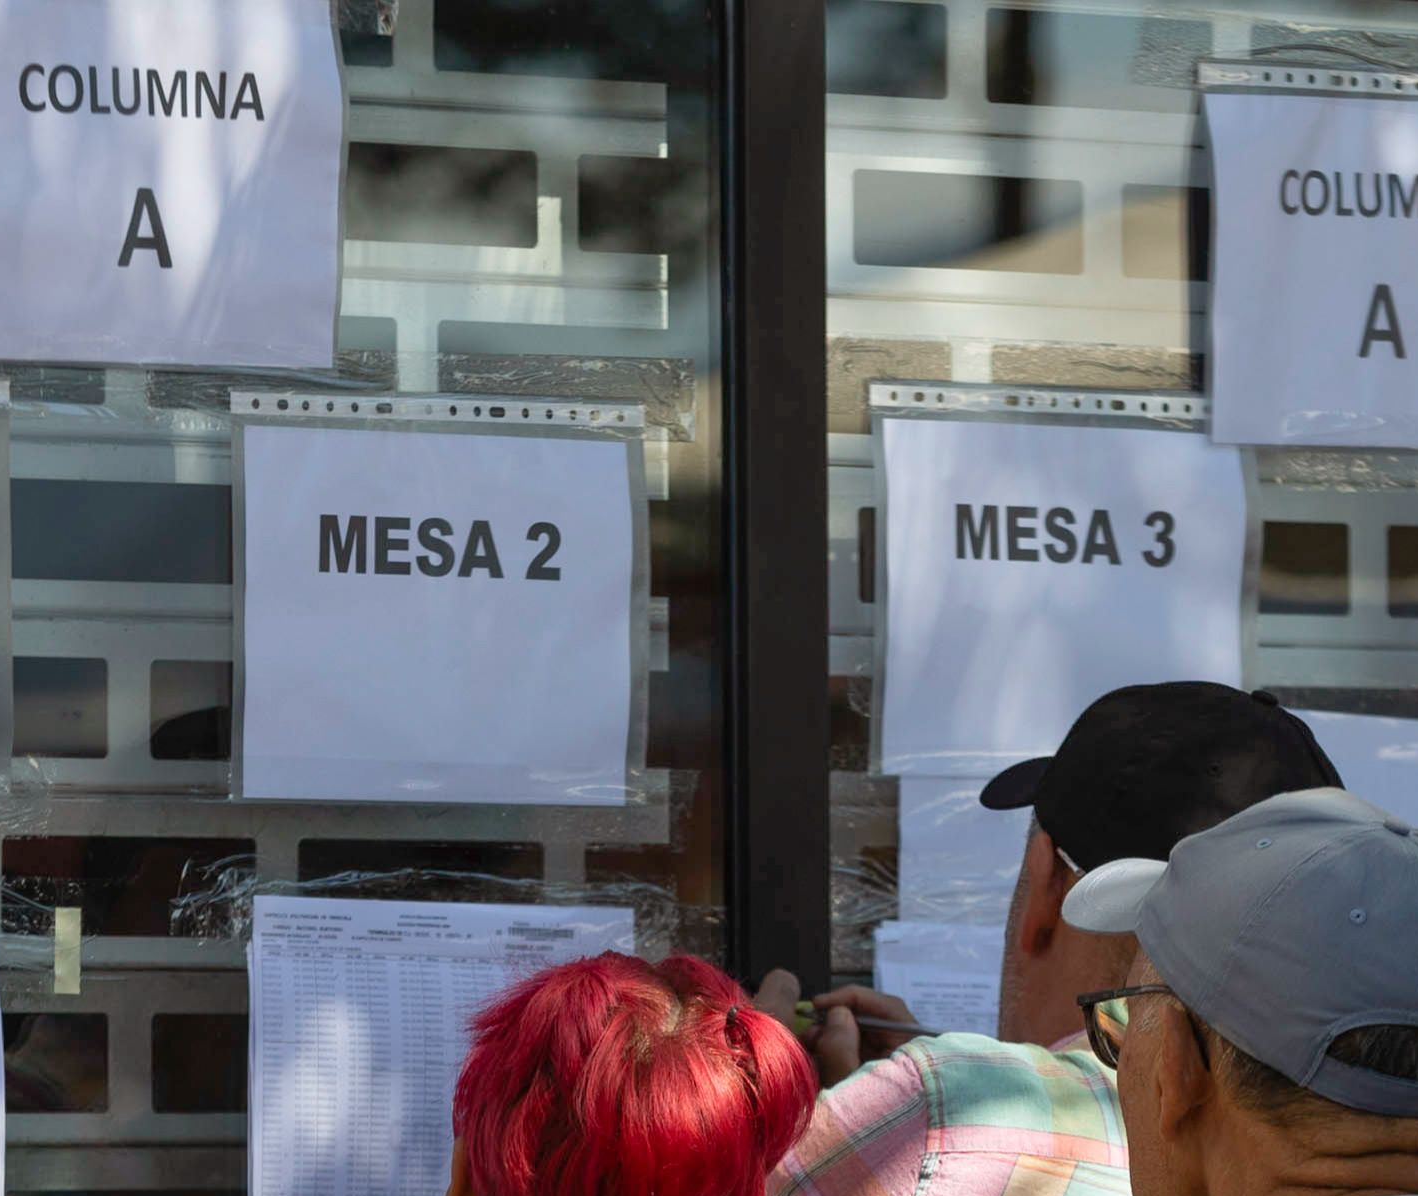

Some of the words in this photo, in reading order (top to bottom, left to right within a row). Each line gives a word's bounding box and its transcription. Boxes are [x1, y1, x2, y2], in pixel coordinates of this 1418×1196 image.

[17, 63, 266, 121] COLUMNA
[116, 187, 174, 270] A
[1357, 283, 1407, 360] A
[318, 513, 505, 579] MESA
[525, 521, 563, 583] 2
[954, 503, 1122, 566] MESA
[1140, 510, 1177, 568] 3
